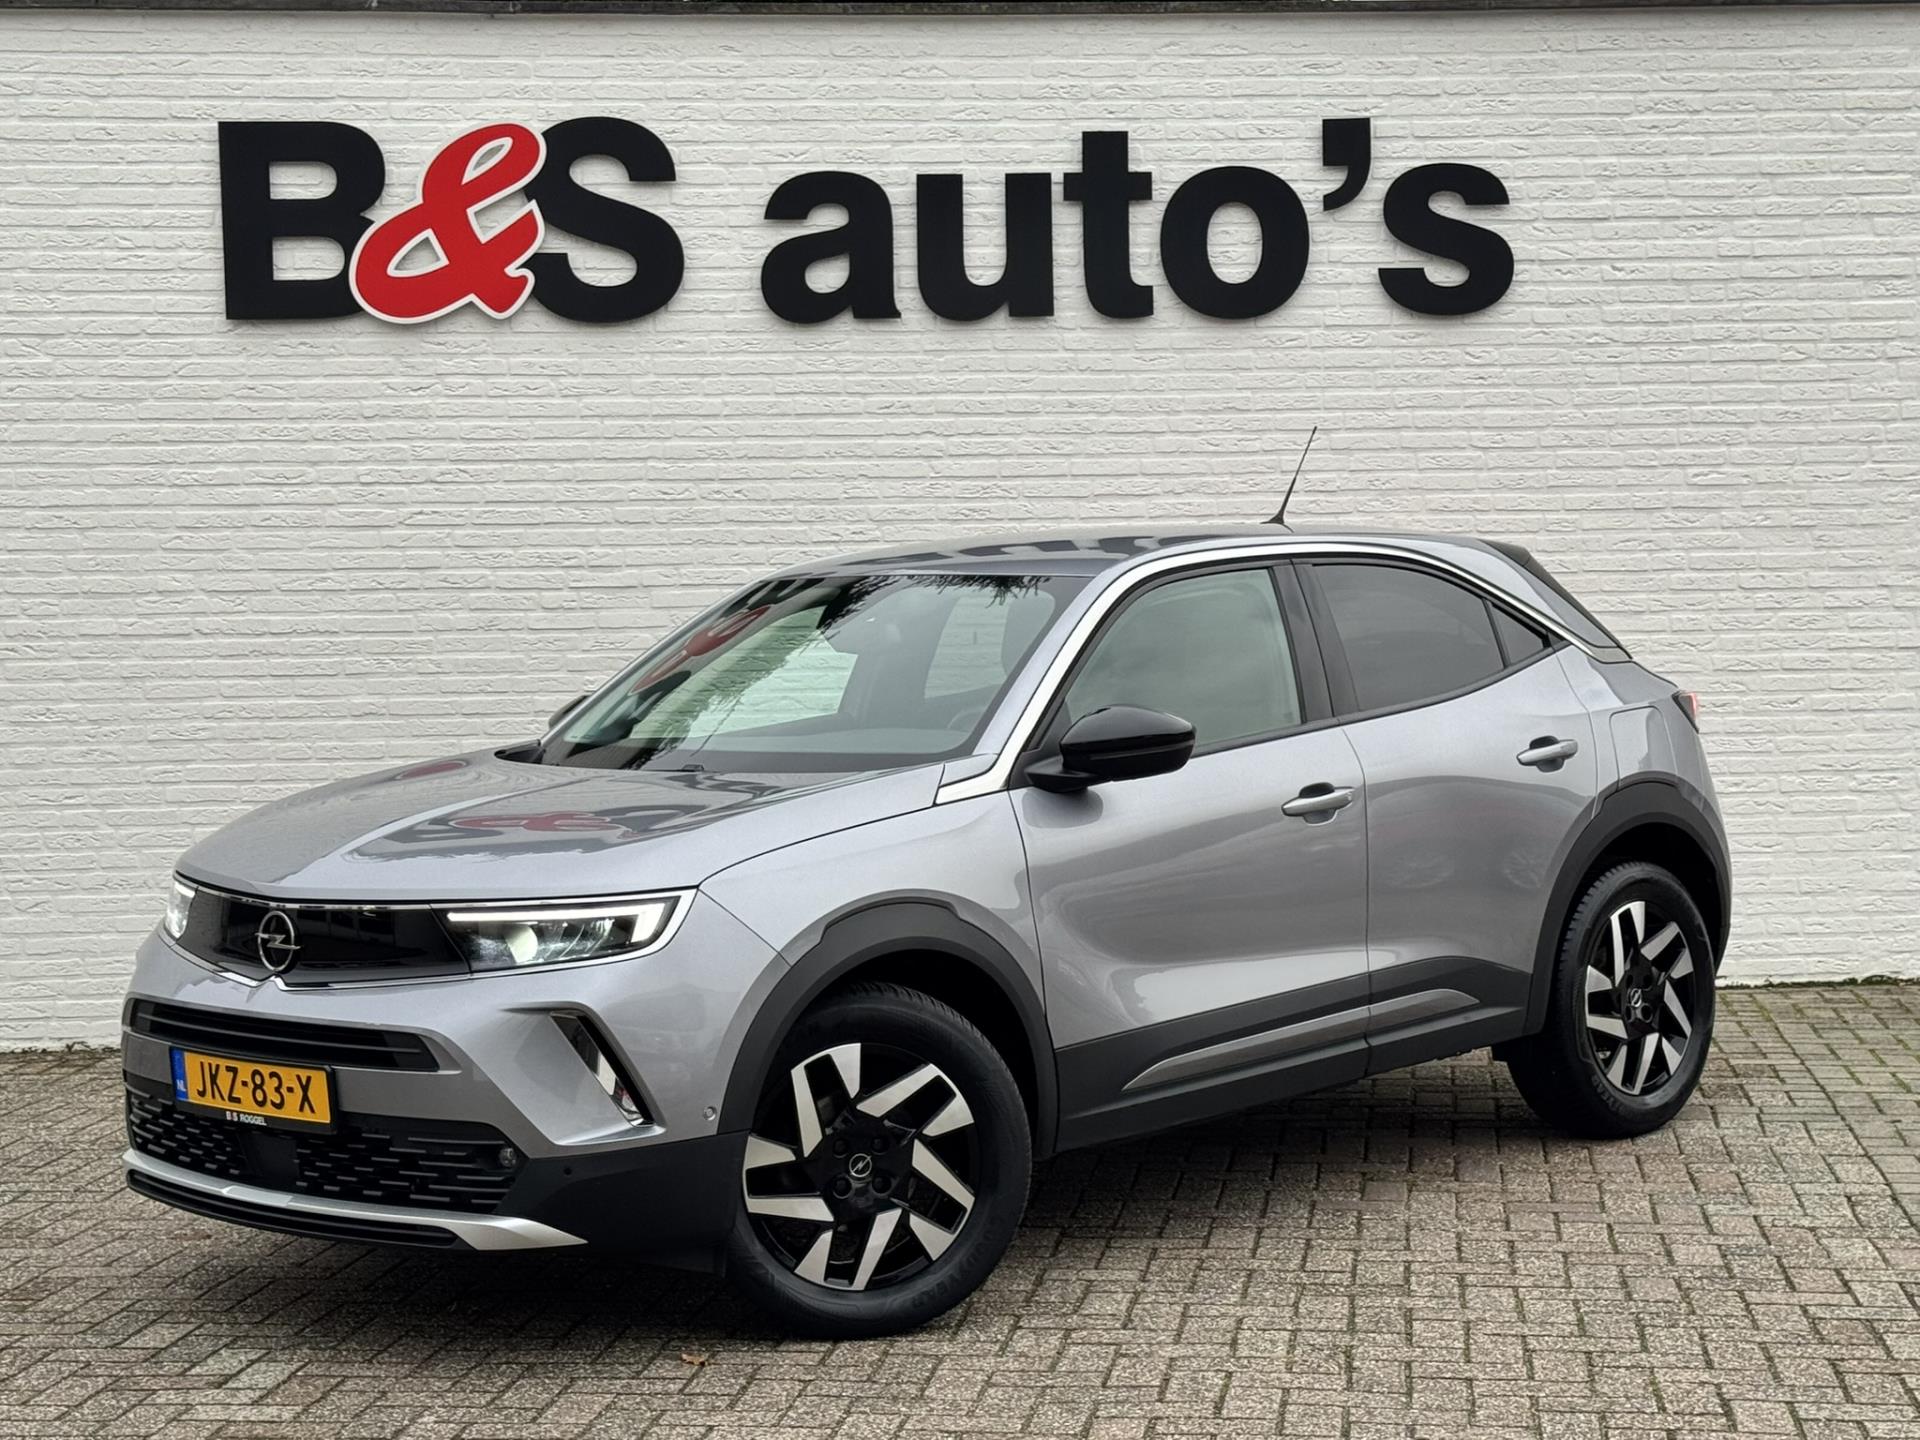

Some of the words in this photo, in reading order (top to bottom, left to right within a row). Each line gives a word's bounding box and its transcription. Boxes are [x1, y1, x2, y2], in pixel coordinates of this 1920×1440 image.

[218, 117, 684, 324] B&S
[760, 117, 1515, 324] auto's
[176, 1079, 186, 1092] NL
[196, 1061, 316, 1114] JKZ-83-X
[239, 1113, 267, 1126] ROGGEL
